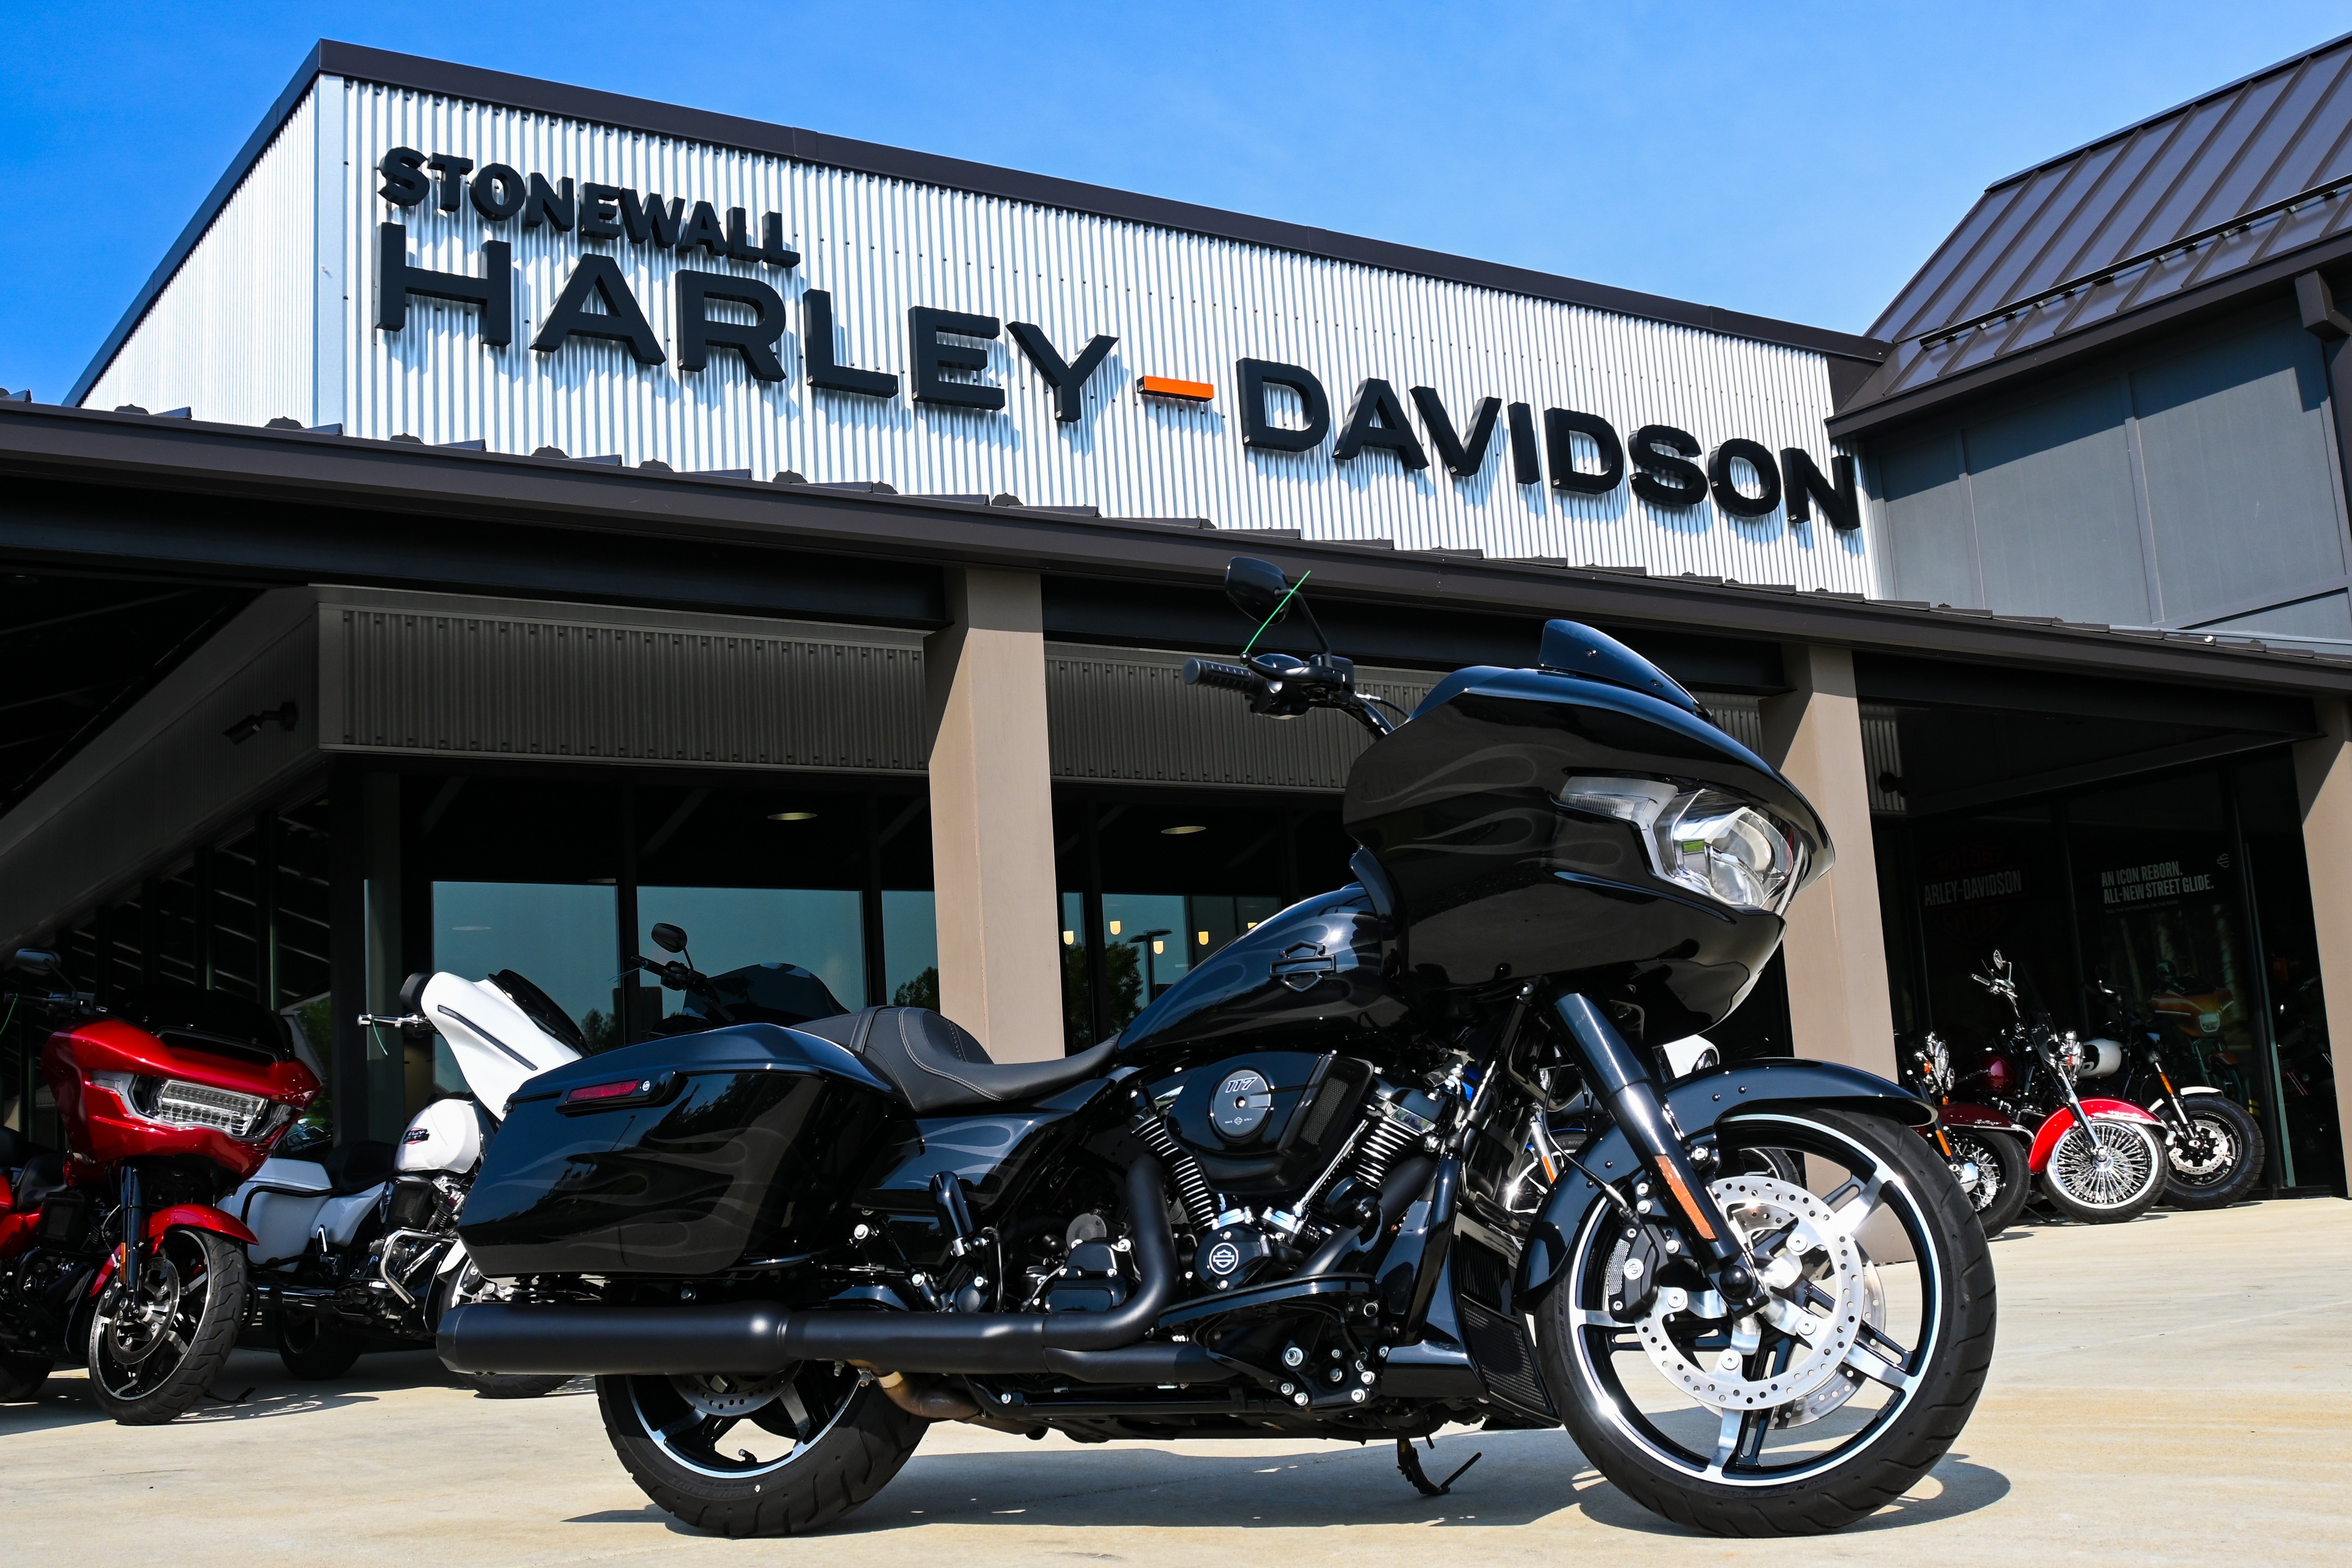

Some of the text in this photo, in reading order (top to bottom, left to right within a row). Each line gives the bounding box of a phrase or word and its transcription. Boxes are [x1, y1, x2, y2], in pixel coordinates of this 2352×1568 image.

[377, 147, 800, 268] STONEWALL
[374, 222, 1861, 530] HARLEY-DAVIDSON
[2101, 861, 2183, 887] AN ICON REBORN.
[1924, 870, 2022, 907] ARLEY-DAVIDSON
[2104, 884, 2145, 904] ALL-NEW
[2146, 878, 2180, 898] STREET
[1225, 1076, 1258, 1093] 117
[713, 1485, 770, 1497] DNLOP
